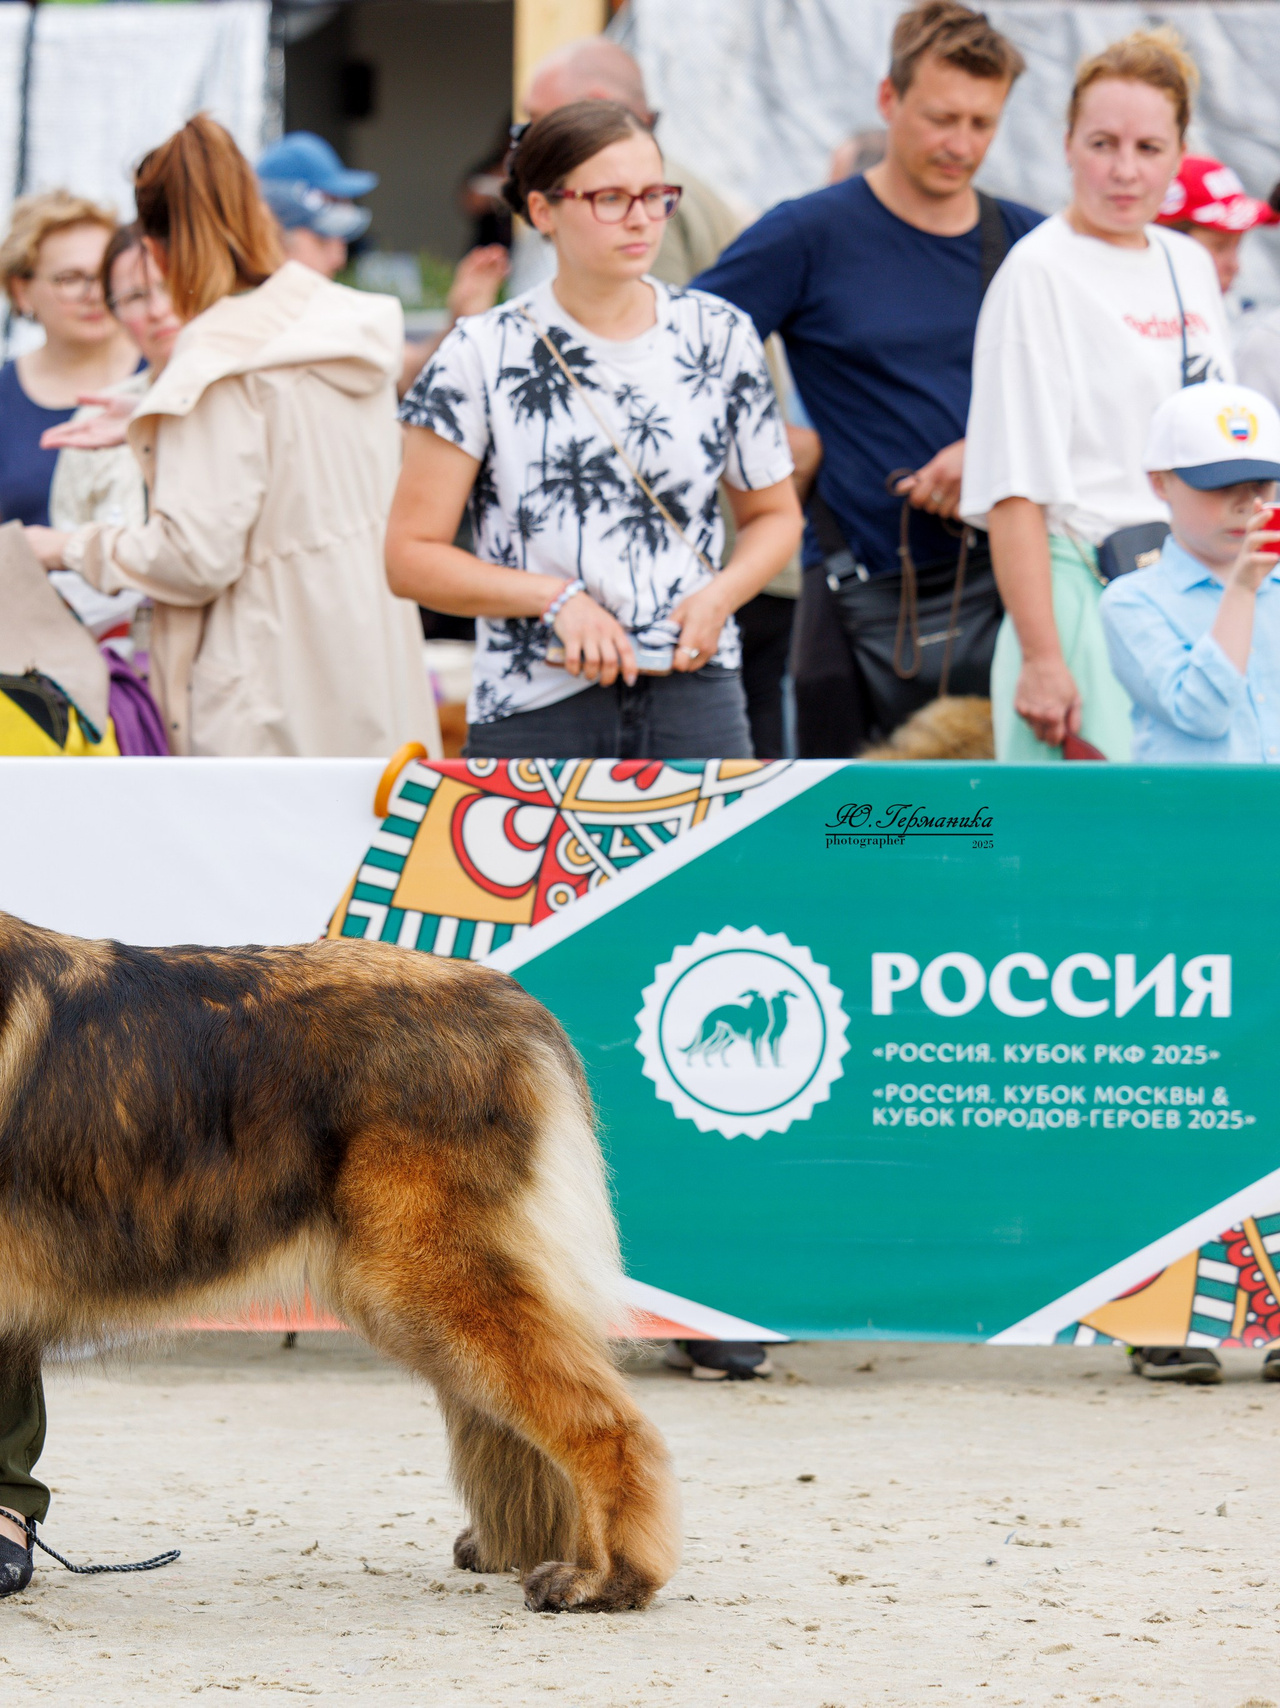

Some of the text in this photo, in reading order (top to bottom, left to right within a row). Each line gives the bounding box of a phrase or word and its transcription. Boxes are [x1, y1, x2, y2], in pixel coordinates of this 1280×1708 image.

[871, 951, 1232, 1018] РОССИЯ
[872, 1042, 1220, 1065] «РОССИЯ. КУБОК РКФ 2025»
[872, 1083, 1230, 1107] «РОССИЯ. КУБОК МОСКВЫ &
[872, 1106, 1257, 1131] КУБОК ГОРОДОВ-ГЕРОЕВ 2025»
